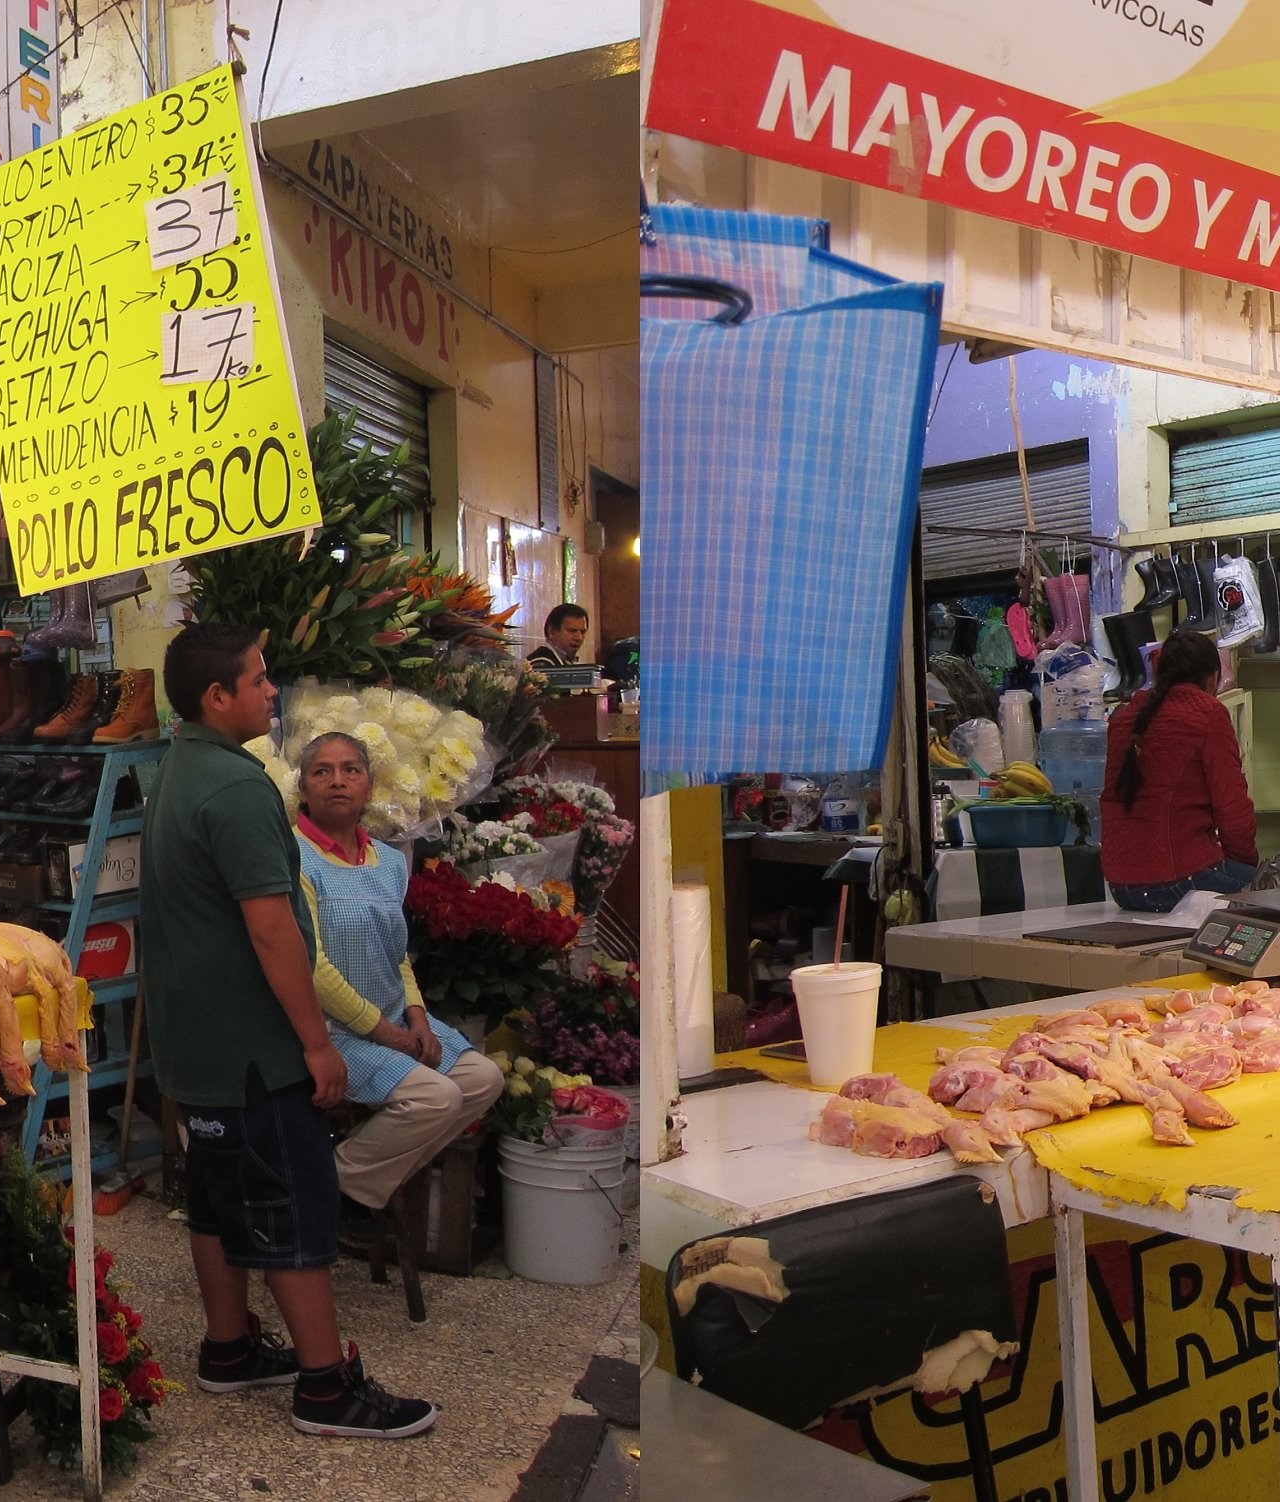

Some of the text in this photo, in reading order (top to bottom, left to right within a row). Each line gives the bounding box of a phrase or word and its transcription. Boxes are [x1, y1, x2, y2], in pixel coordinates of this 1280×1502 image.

[39, 117, 138, 189] ENTERO
[757, 51, 1171, 235] MAYOREO
[1193, 178, 1236, 250] Y
[152, 180, 236, 260] 37
[328, 215, 426, 347] KIKO
[159, 307, 248, 387] 17
[17, 436, 291, 589] POLLO FRESCO
